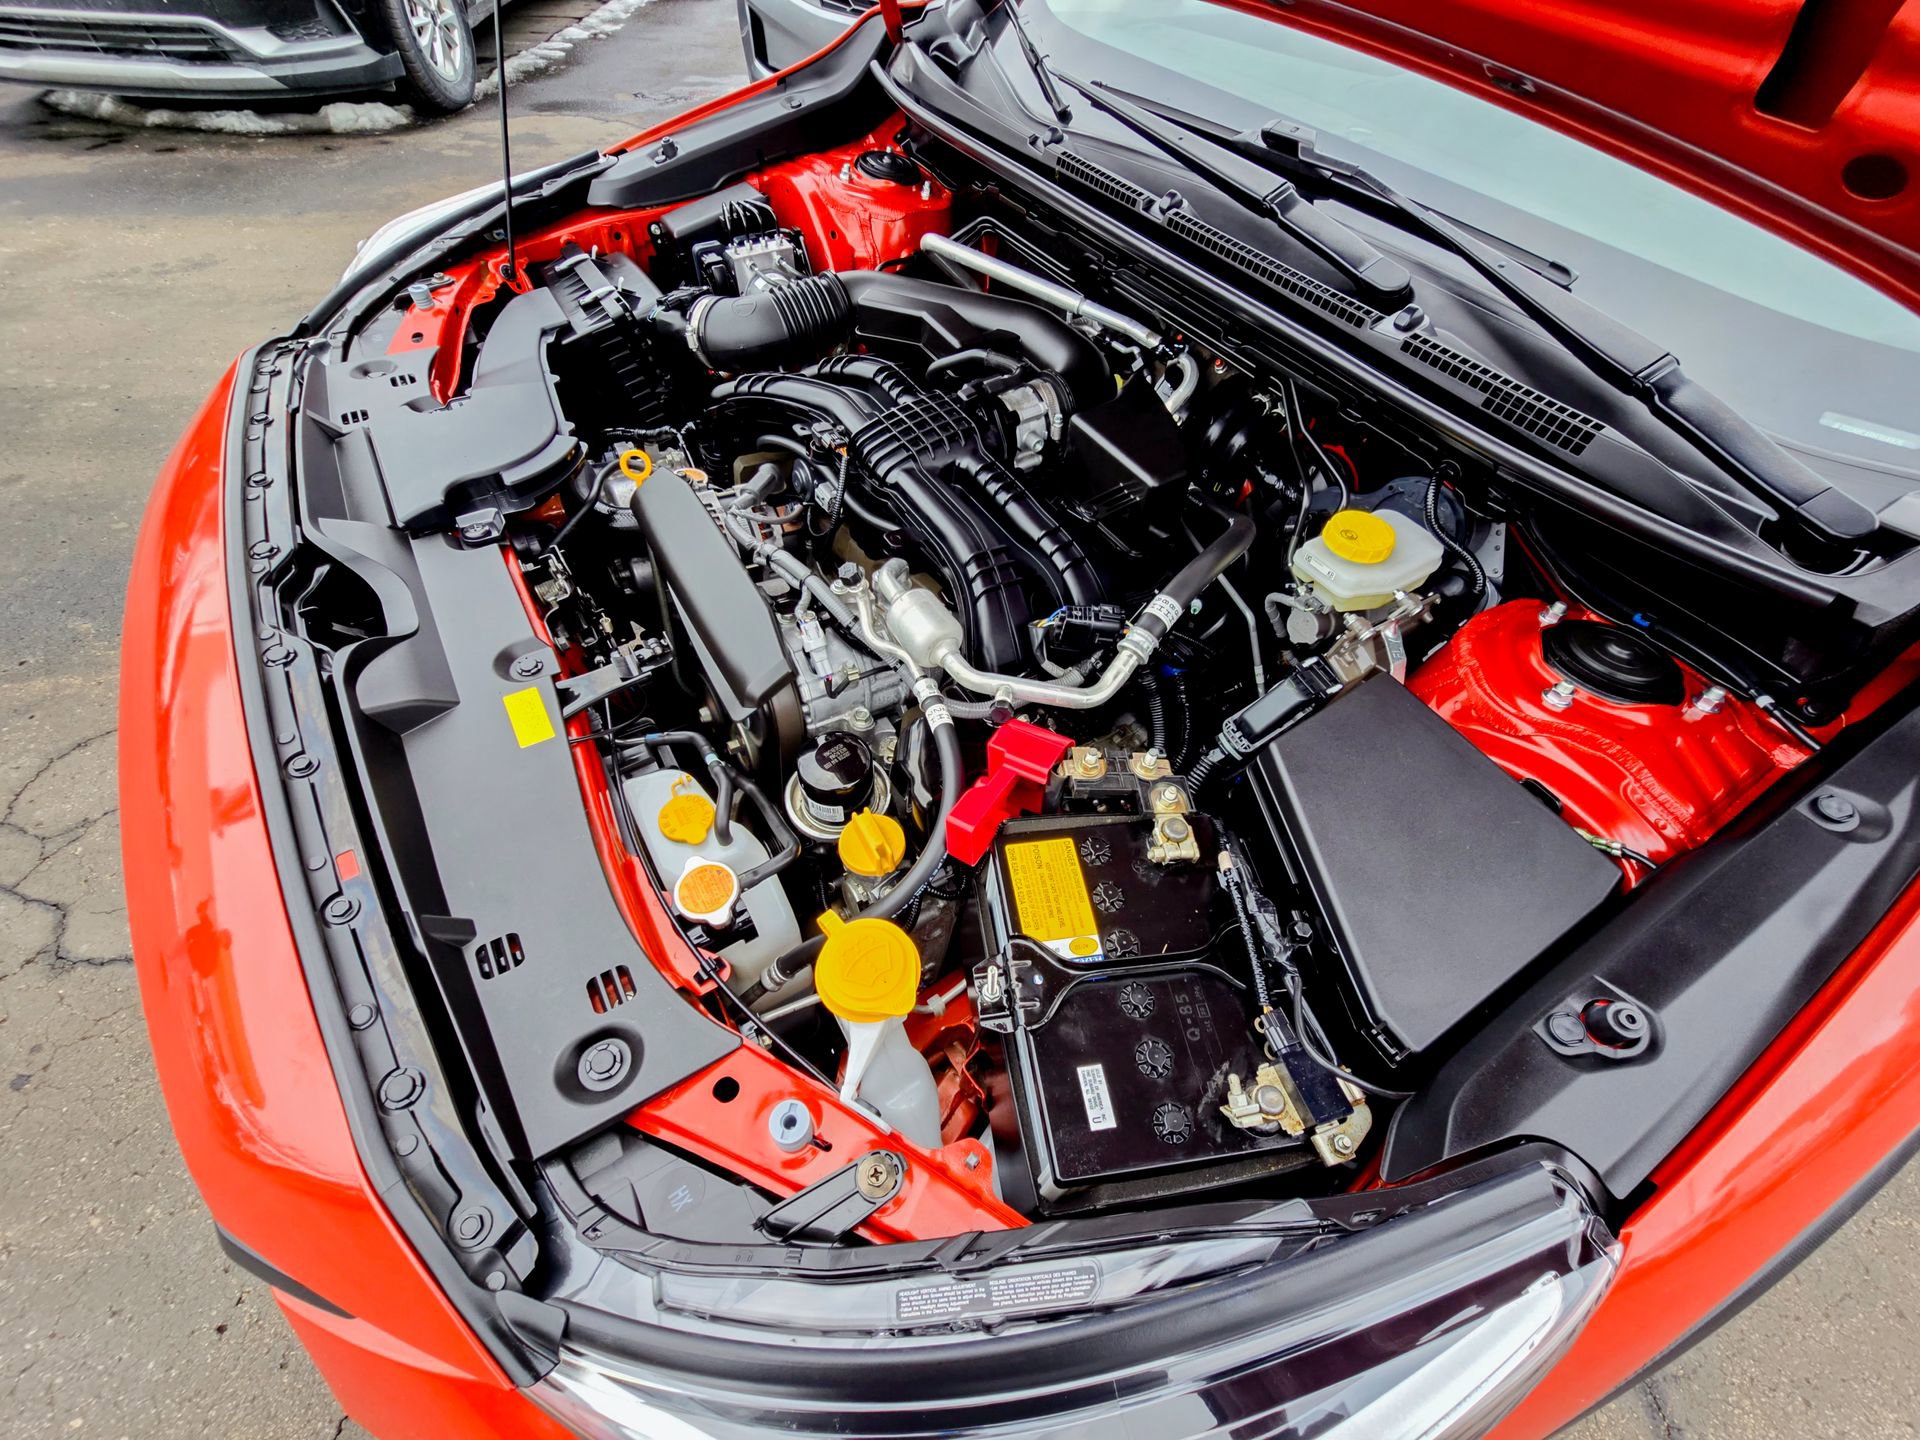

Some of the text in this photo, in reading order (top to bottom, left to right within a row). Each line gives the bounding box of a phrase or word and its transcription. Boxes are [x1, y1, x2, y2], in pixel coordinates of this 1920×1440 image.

[1031, 844, 1044, 870] POISON
[1063, 840, 1076, 867] DANGER
[1175, 994, 1200, 1041] Q-85
[1092, 1116, 1102, 1125] U
[667, 1185, 693, 1212] HX
